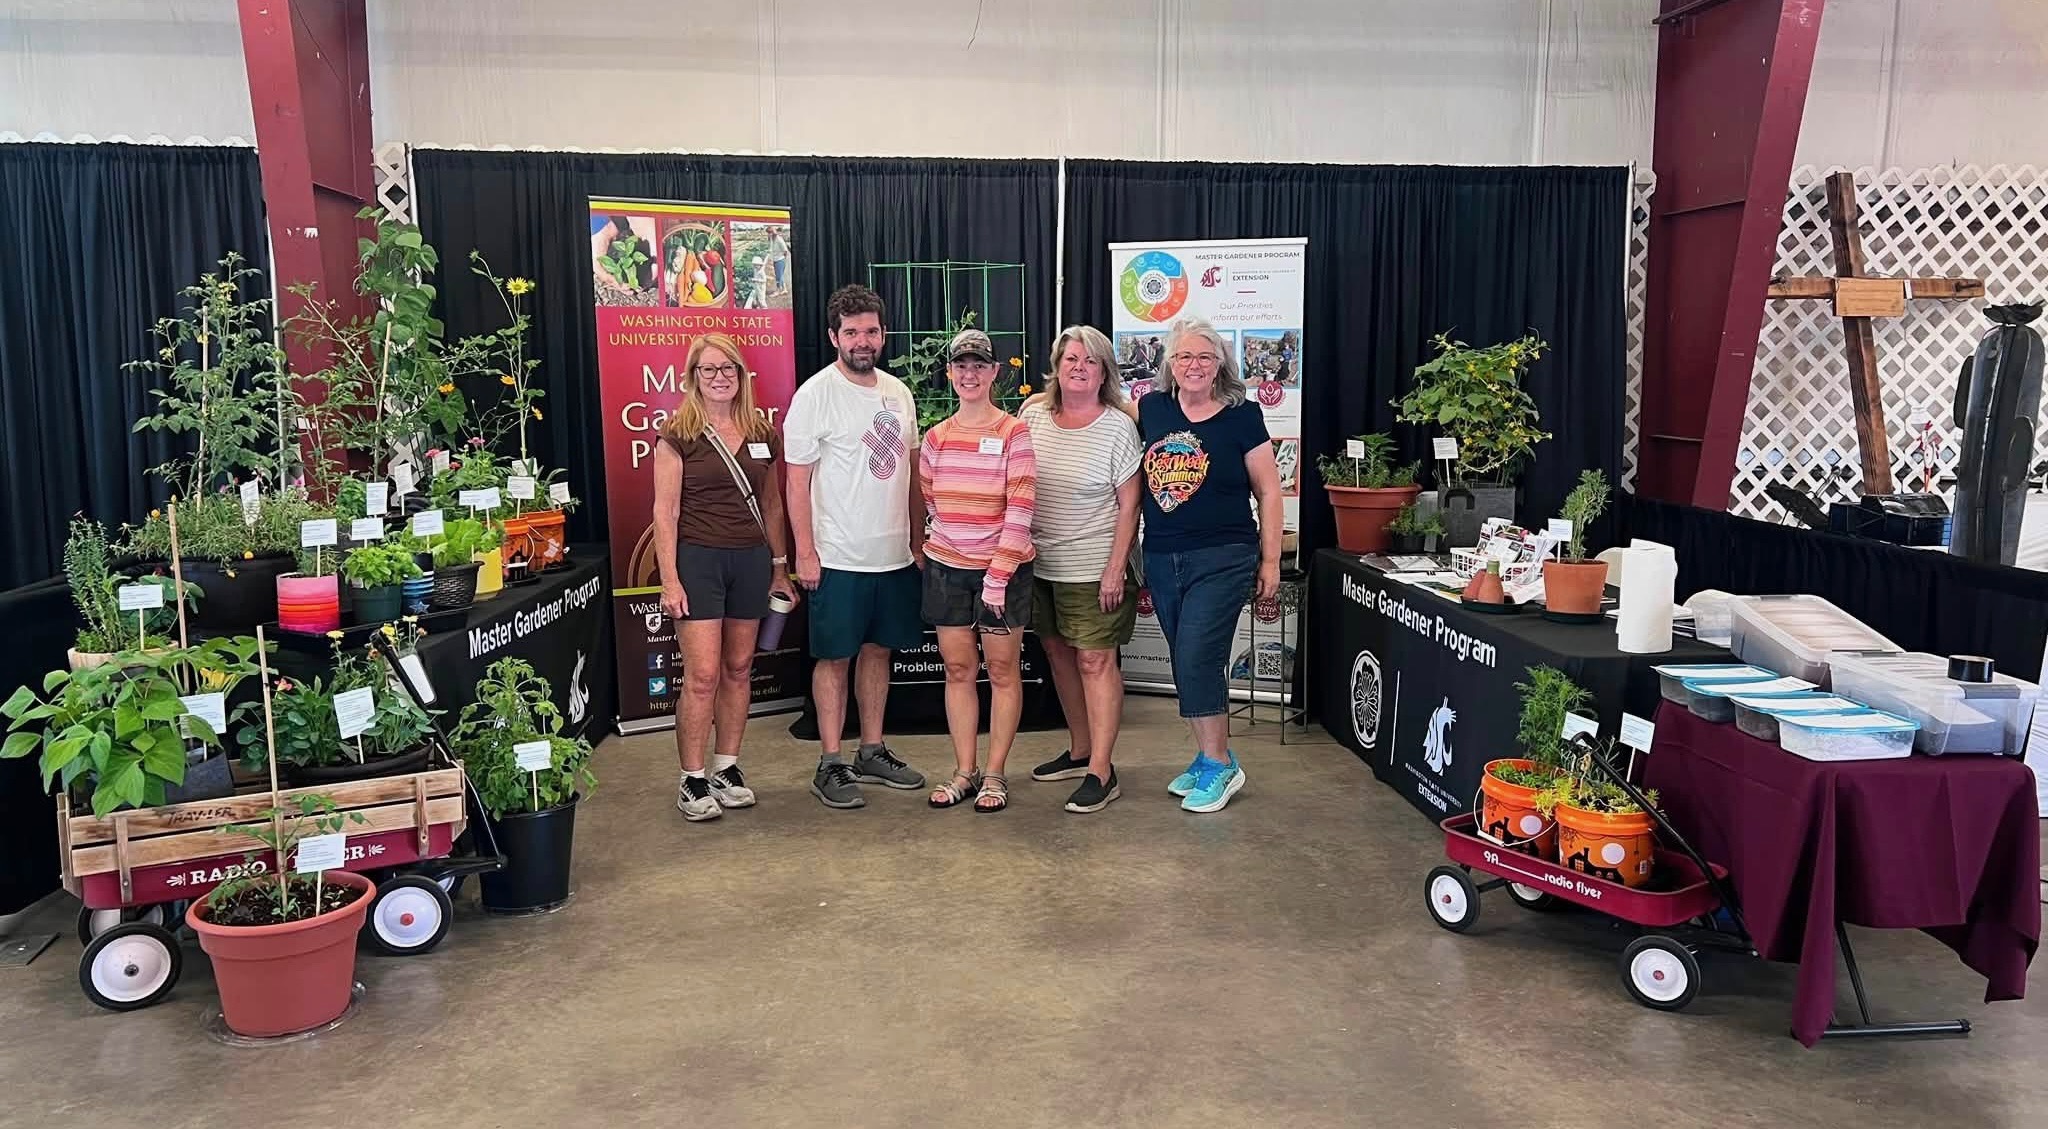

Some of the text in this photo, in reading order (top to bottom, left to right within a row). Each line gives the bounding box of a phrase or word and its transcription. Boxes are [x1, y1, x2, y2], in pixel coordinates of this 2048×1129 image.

[1224, 252, 1263, 260] GARDENER
[619, 314, 772, 329] WASHINGTON STATE
[468, 620, 512, 660] Master
[514, 597, 562, 638] Gardener
[1342, 573, 1497, 668] Master Gardener Program
[1418, 782, 1448, 813] EXTENSION
[190, 860, 267, 885] RADIO
[1543, 873, 1575, 890] radio
[1576, 881, 1603, 900] flyer
